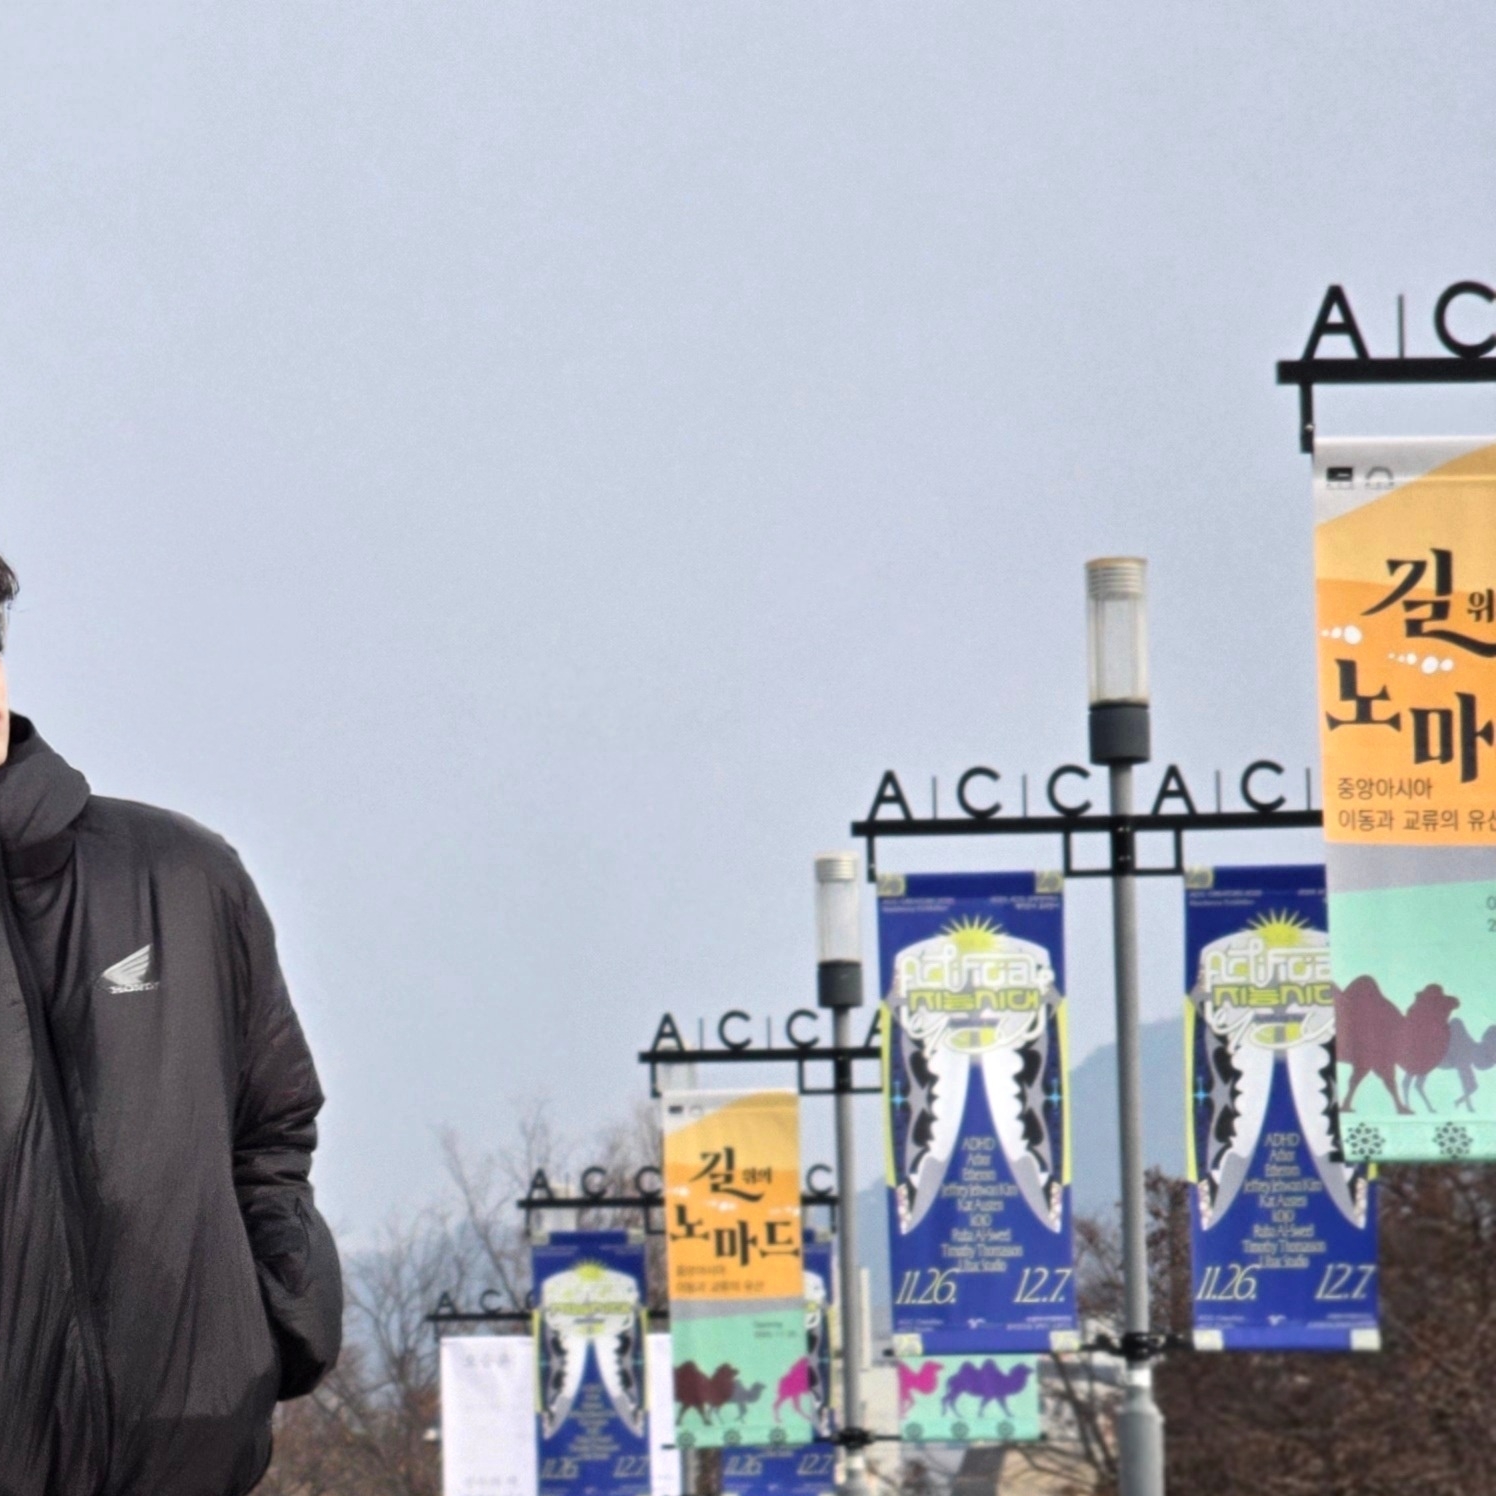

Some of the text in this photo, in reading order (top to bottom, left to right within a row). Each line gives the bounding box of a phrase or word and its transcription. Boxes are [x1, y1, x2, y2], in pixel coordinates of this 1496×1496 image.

[1360, 547, 1496, 658] 길
[1325, 657, 1495, 784] 노마
[1337, 777, 1432, 801] 중앙아시아
[1338, 809, 1395, 832] 이동과
[1402, 809, 1459, 832] 교류의
[688, 1146, 765, 1203] 길
[669, 1203, 800, 1267] 노마드
